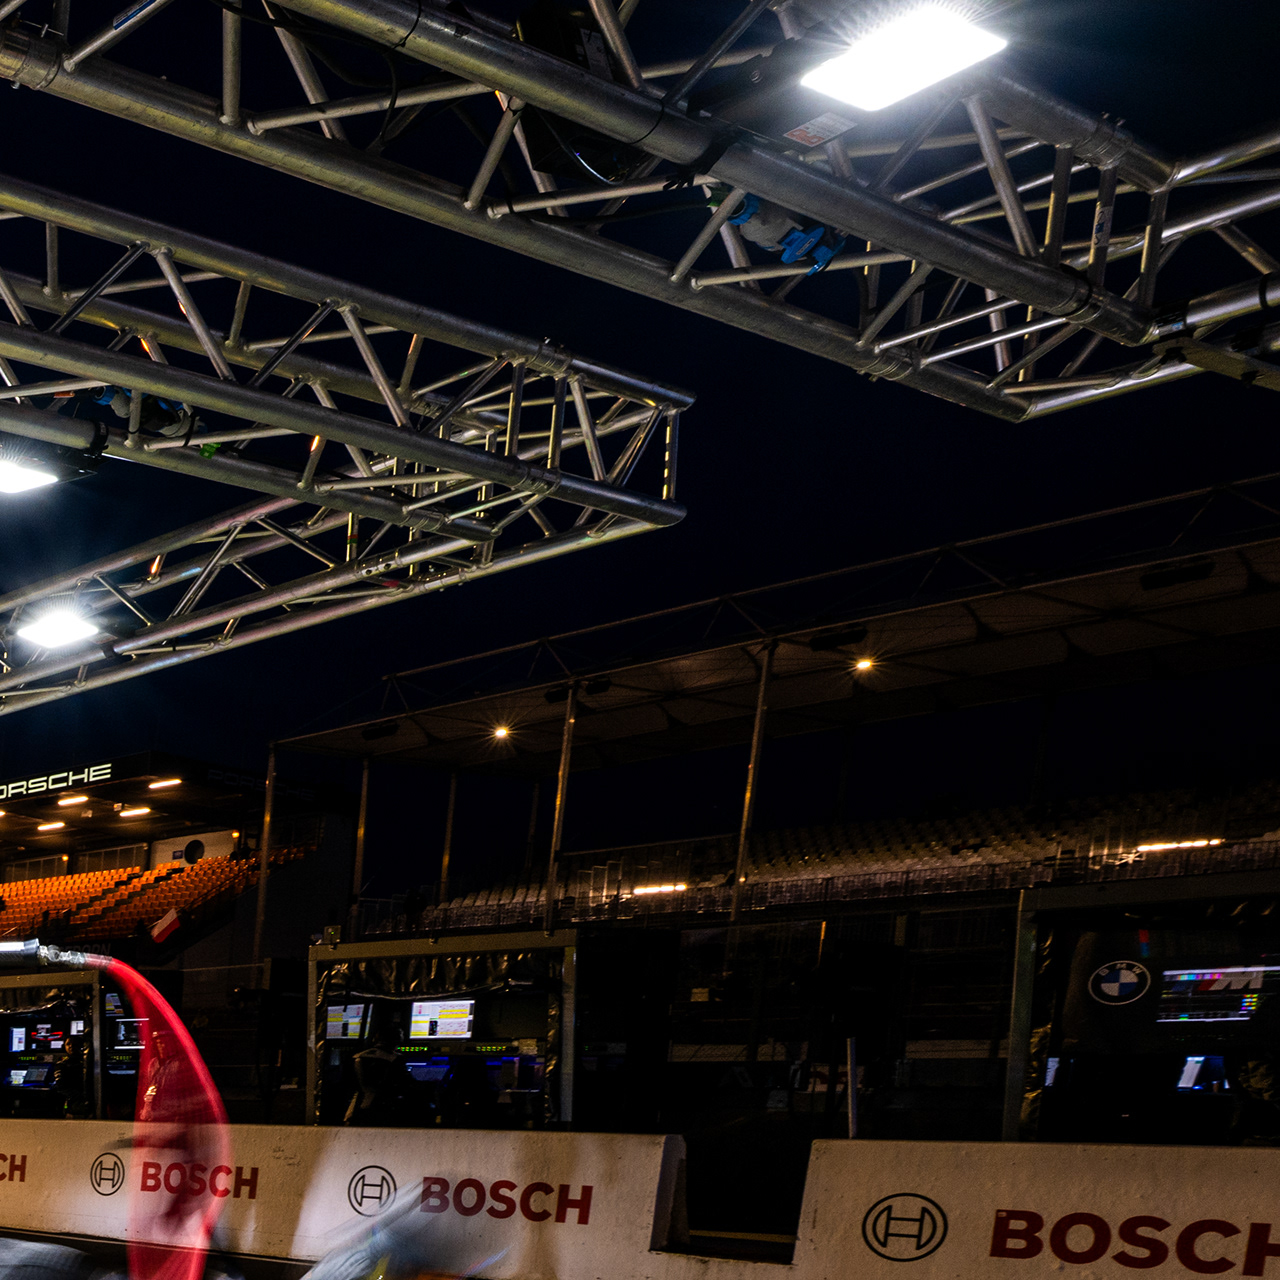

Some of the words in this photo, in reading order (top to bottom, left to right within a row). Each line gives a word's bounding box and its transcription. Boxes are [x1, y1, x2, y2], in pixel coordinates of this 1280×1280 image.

[140, 1161, 260, 1200] BOSCH
[420, 1176, 594, 1226] BOSCH
[989, 1208, 1280, 1278] BOSCH
